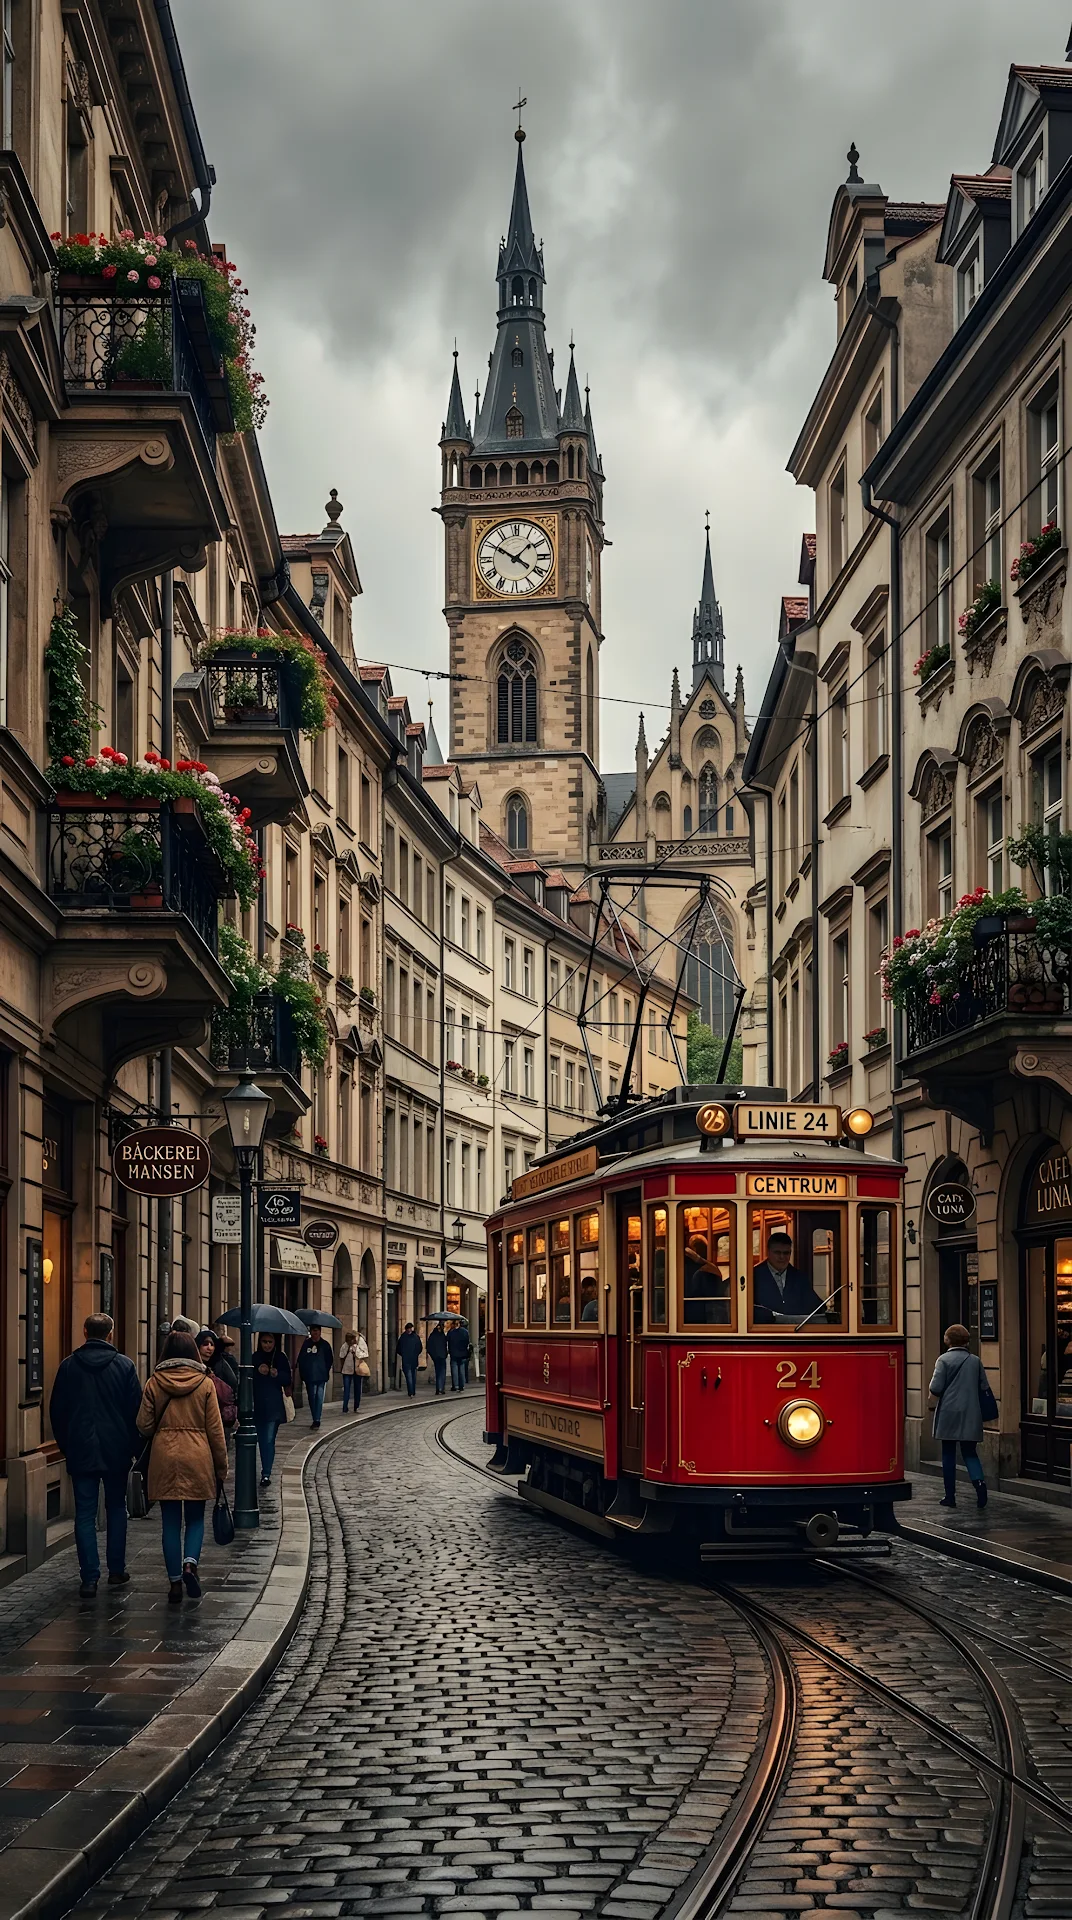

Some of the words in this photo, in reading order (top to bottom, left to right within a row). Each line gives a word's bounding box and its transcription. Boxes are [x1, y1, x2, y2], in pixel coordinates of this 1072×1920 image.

[748, 1110, 797, 1130] LINIE
[803, 1112, 829, 1131] 24
[128, 1164, 195, 1179] MANSEN
[753, 1177, 838, 1194] CENTRUM
[1037, 1183, 1072, 1213] LUNA
[936, 1204, 965, 1215] LUNA
[775, 1360, 822, 1389] 24
